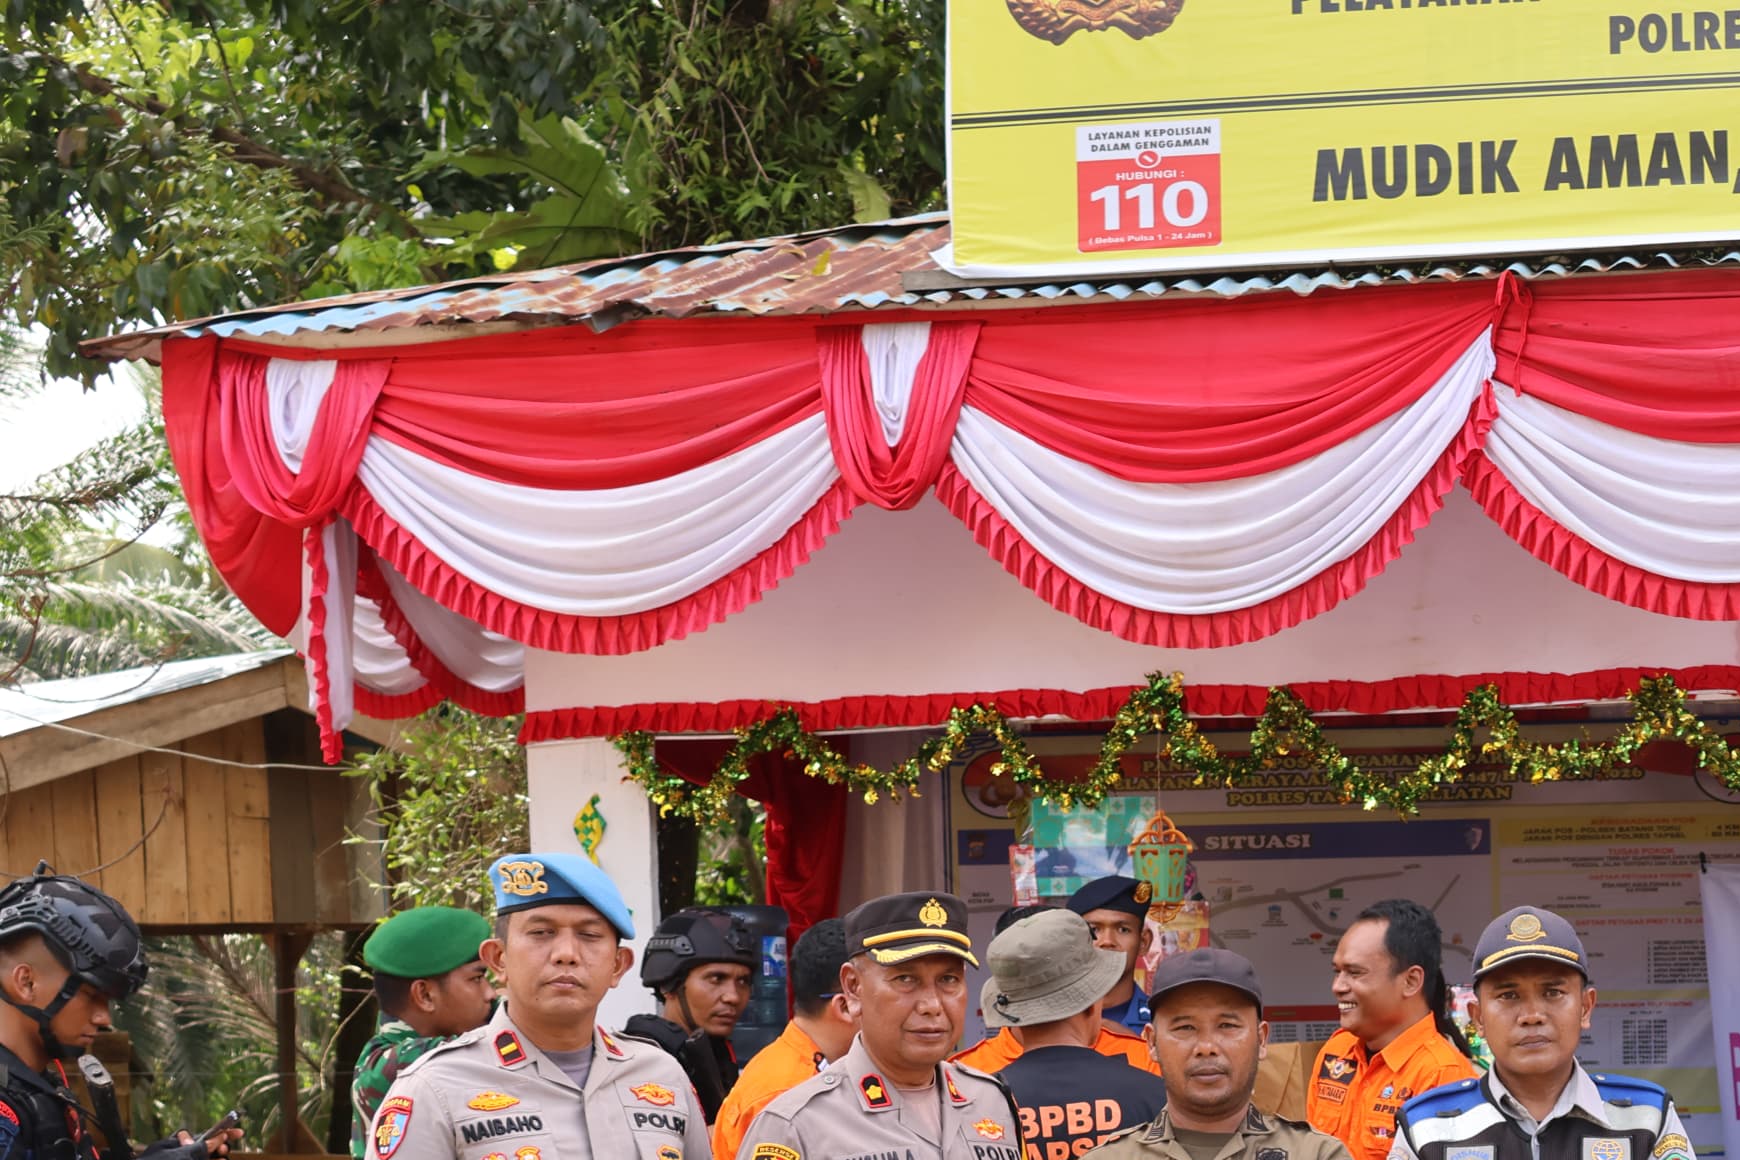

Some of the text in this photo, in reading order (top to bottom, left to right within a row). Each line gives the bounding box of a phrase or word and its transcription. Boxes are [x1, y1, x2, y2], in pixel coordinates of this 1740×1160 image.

[1088, 126, 1212, 141] LAYANAN KEPOLISIAN
[1090, 138, 1210, 153] DALAM GENGGAMAN
[1116, 170, 1177, 181] HUBUNGI
[1312, 141, 1520, 203] MUDIK
[1090, 180, 1209, 231] 110
[1227, 790, 1307, 807] POLRES
[1205, 833, 1312, 851] SITUASI
[462, 1113, 543, 1144] NAIBAHO
[633, 1111, 686, 1137] POLRI
[1019, 1098, 1122, 1139] BPBD
